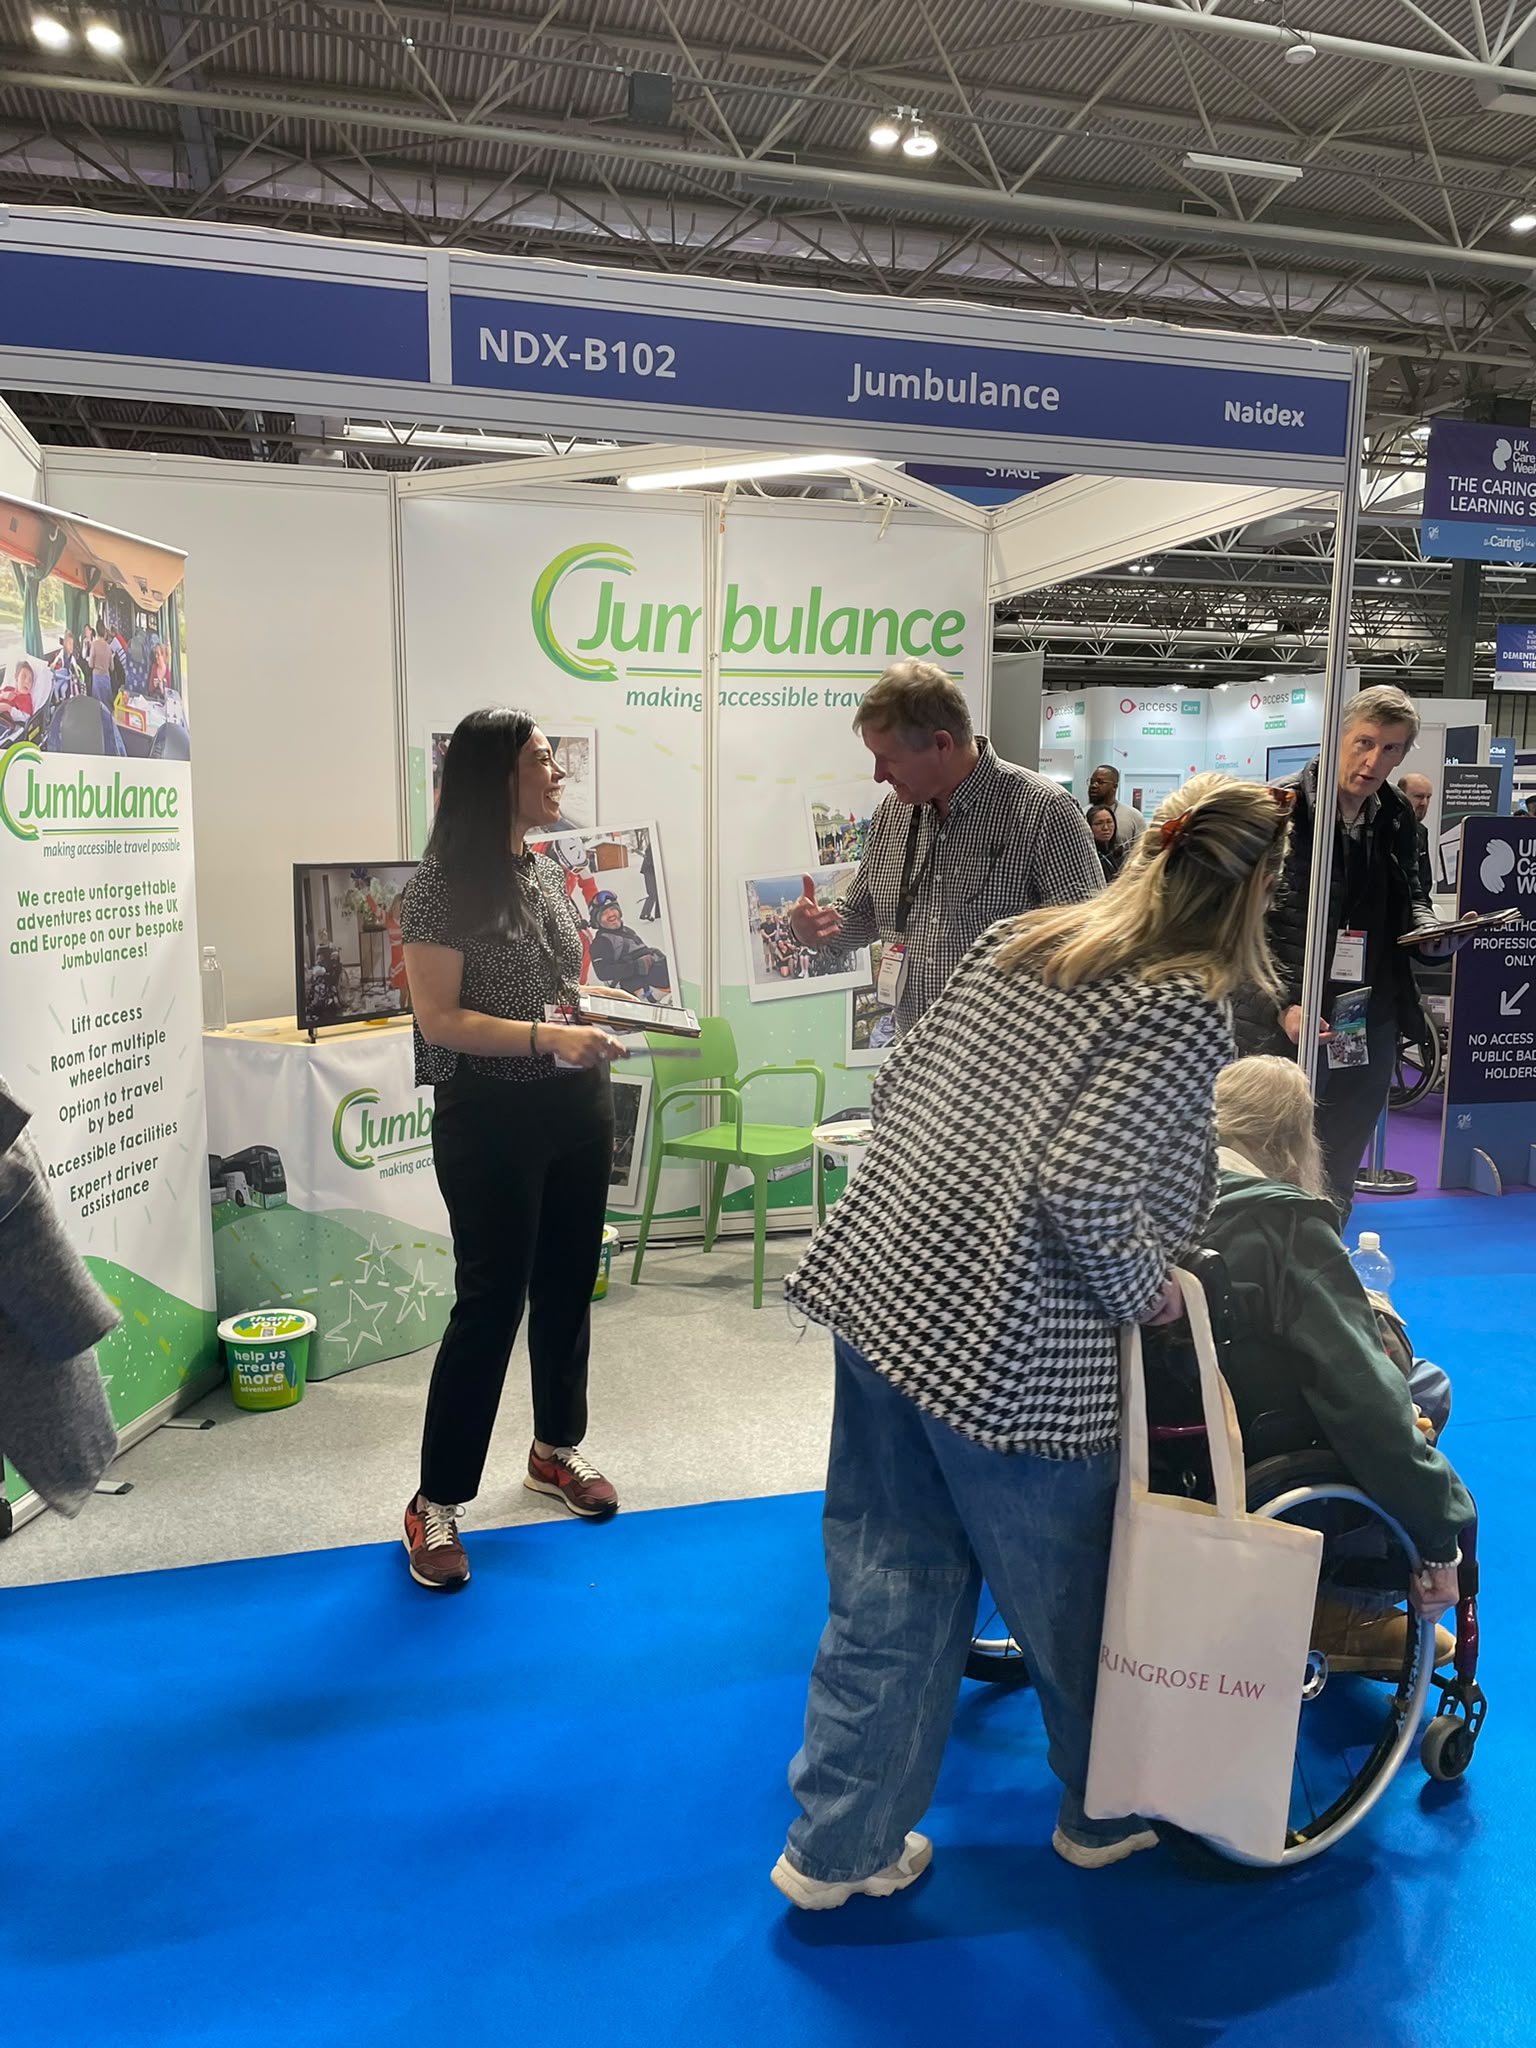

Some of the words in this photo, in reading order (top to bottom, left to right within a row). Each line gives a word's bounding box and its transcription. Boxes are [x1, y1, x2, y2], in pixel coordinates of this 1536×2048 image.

[479, 327, 677, 380] NDX-B102
[848, 363, 1061, 412] Jumbulance
[1224, 400, 1305, 429] Naidex
[1514, 440, 1529, 452] UK
[1513, 452, 1536, 463] Care
[1448, 476, 1478, 493] THE
[1482, 479, 1536, 498] CARING
[1450, 496, 1525, 516] LEARNING
[1490, 535, 1521, 551] Caring
[577, 581, 966, 657] Jumbulance
[626, 686, 702, 713] making
[717, 687, 818, 708] accessible
[1138, 702, 1178, 712] access
[1183, 704, 1198, 712] Care
[1262, 692, 1289, 705] access
[19, 769, 178, 818] Jumbulance
[43, 841, 76, 859] making
[77, 839, 122, 856] accessible
[124, 839, 150, 853] travel
[151, 838, 180, 855] possible
[17, 890, 39, 907] We
[44, 886, 85, 904] create
[89, 879, 176, 902] unforgettable
[17, 908, 91, 931] adventures
[95, 902, 140, 920] across
[144, 901, 164, 917] the
[166, 899, 178, 914] UK
[10, 935, 38, 955] and
[42, 930, 87, 951] Europe
[90, 928, 105, 943] on
[108, 925, 131, 941] our
[136, 918, 184, 940] bespoke
[61, 942, 148, 970] Jumbulances!
[1504, 955, 1536, 967] ONLY
[71, 1015, 91, 1035] Lift
[94, 1006, 143, 1029] access
[1468, 1034, 1487, 1045] NO
[1490, 1033, 1534, 1045] ACCESS
[51, 1049, 85, 1072] Room
[88, 1043, 107, 1060] for
[111, 1029, 166, 1055] multiple
[1471, 1050, 1513, 1062] PUBLIC
[69, 1053, 151, 1088] wheelchairs
[1485, 1067, 1536, 1079] HOLDERS
[59, 1095, 100, 1123] Option
[104, 1090, 117, 1105] to
[121, 1076, 164, 1101] travel
[88, 1116, 104, 1134] by
[107, 1104, 134, 1126] bed
[48, 1141, 116, 1180] Accessible
[119, 1120, 178, 1152] facilities
[70, 1171, 112, 1203] Expert
[116, 1155, 159, 1182] driver
[379, 1161, 414, 1179] making
[81, 1179, 150, 1218] assistance
[250, 1314, 299, 1323] thank
[251, 1320, 290, 1330] you!
[234, 1350, 264, 1363] help
[269, 1350, 286, 1360] us
[237, 1361, 285, 1373] create
[239, 1373, 284, 1385] more
[240, 1384, 284, 1393] adventures!
[1100, 1645, 1210, 1691] RINGROSE
